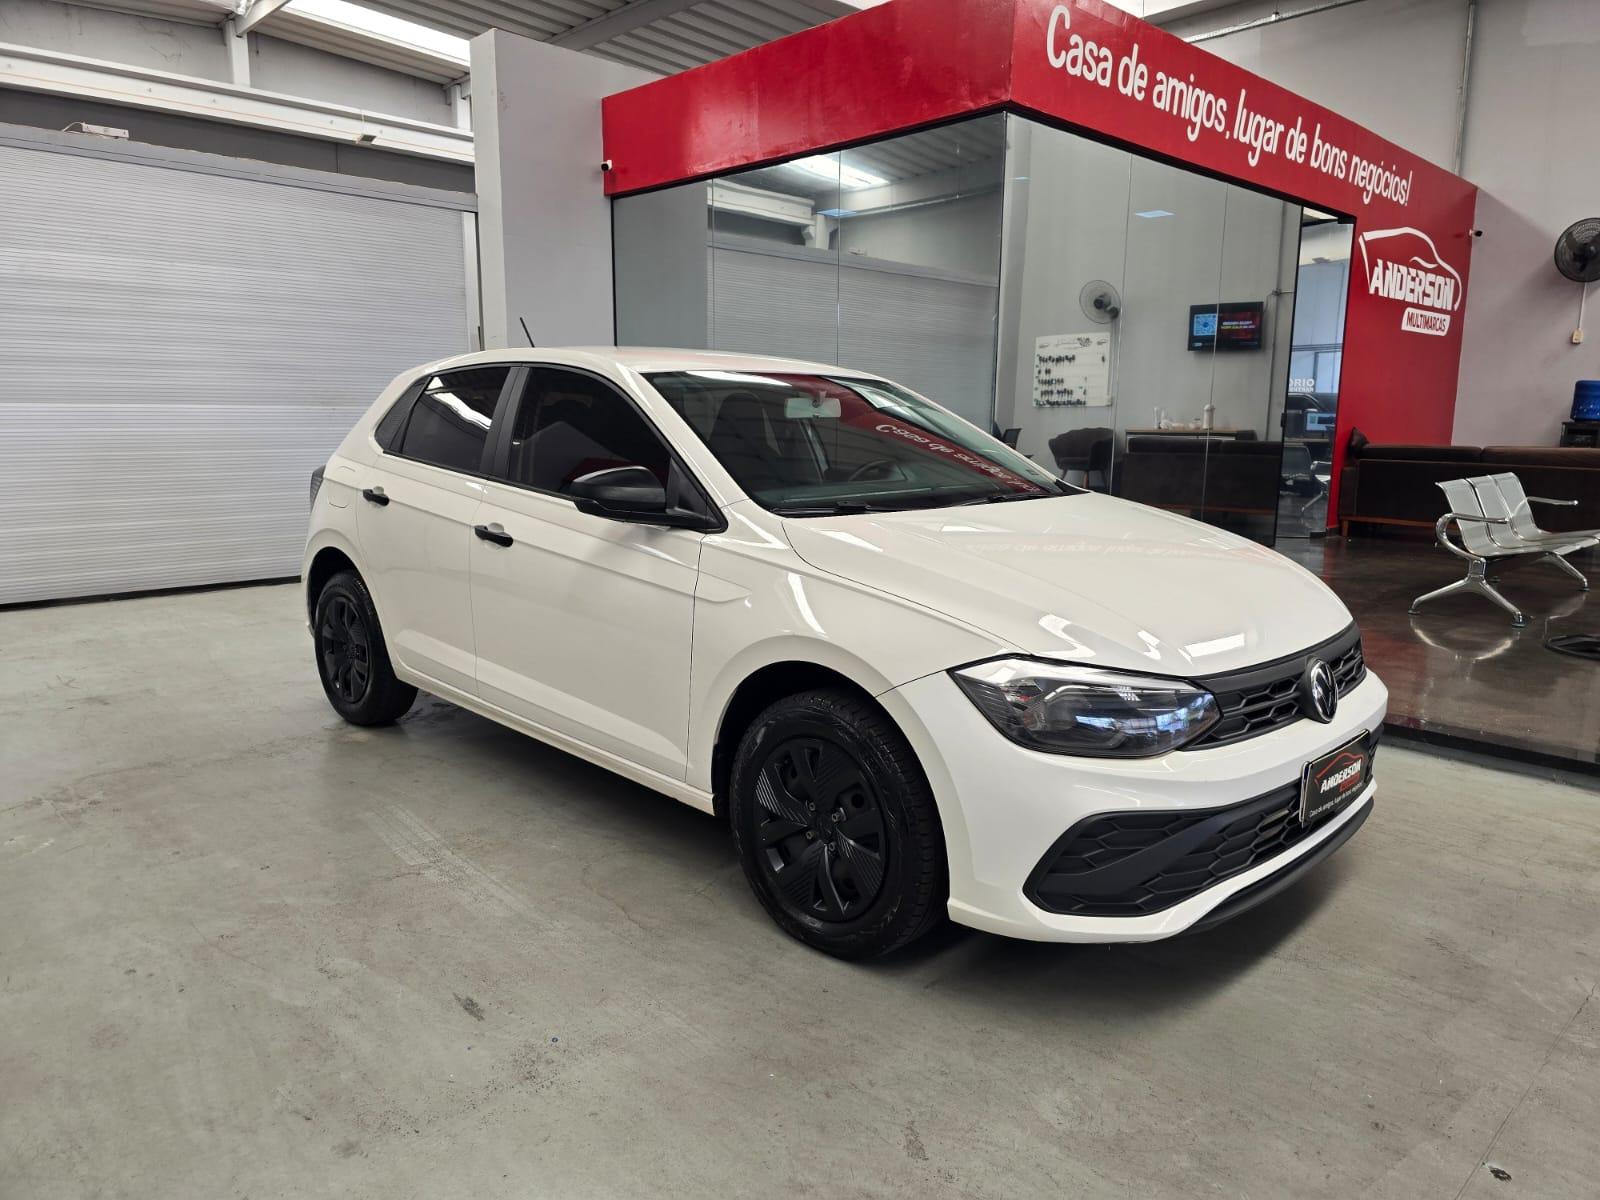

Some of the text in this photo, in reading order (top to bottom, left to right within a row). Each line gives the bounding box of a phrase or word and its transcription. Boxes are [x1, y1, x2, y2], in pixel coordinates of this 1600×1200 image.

[1046, 4, 1413, 207] Casa de amigos, lugar de bons negócios!
[1369, 258, 1455, 311] ANDERSON
[1407, 311, 1446, 333] MULTIMARCAS
[1320, 758, 1361, 793] ANDERSON
